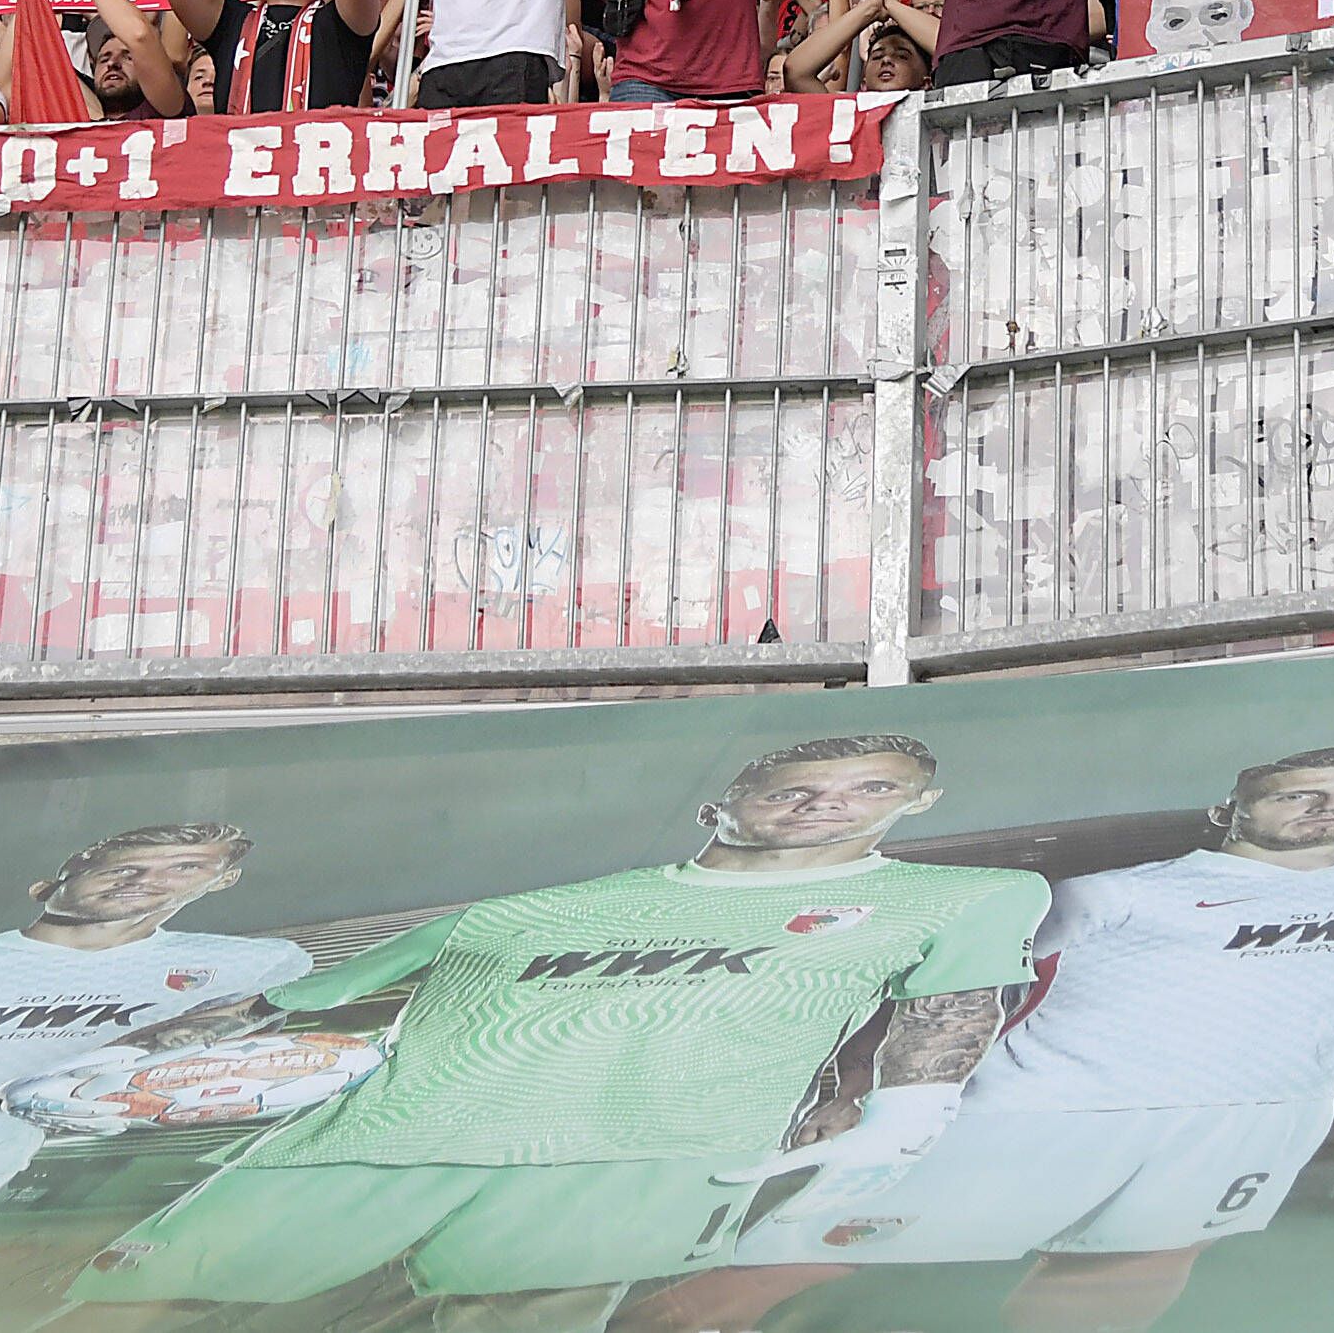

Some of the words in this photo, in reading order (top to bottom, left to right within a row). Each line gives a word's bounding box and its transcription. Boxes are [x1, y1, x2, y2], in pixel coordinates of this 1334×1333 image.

[224, 101, 798, 198] ERHALTEN
[1290, 912, 1318, 923] 50
[515, 945, 779, 983] WWK
[1215, 1172, 1270, 1213] 6
